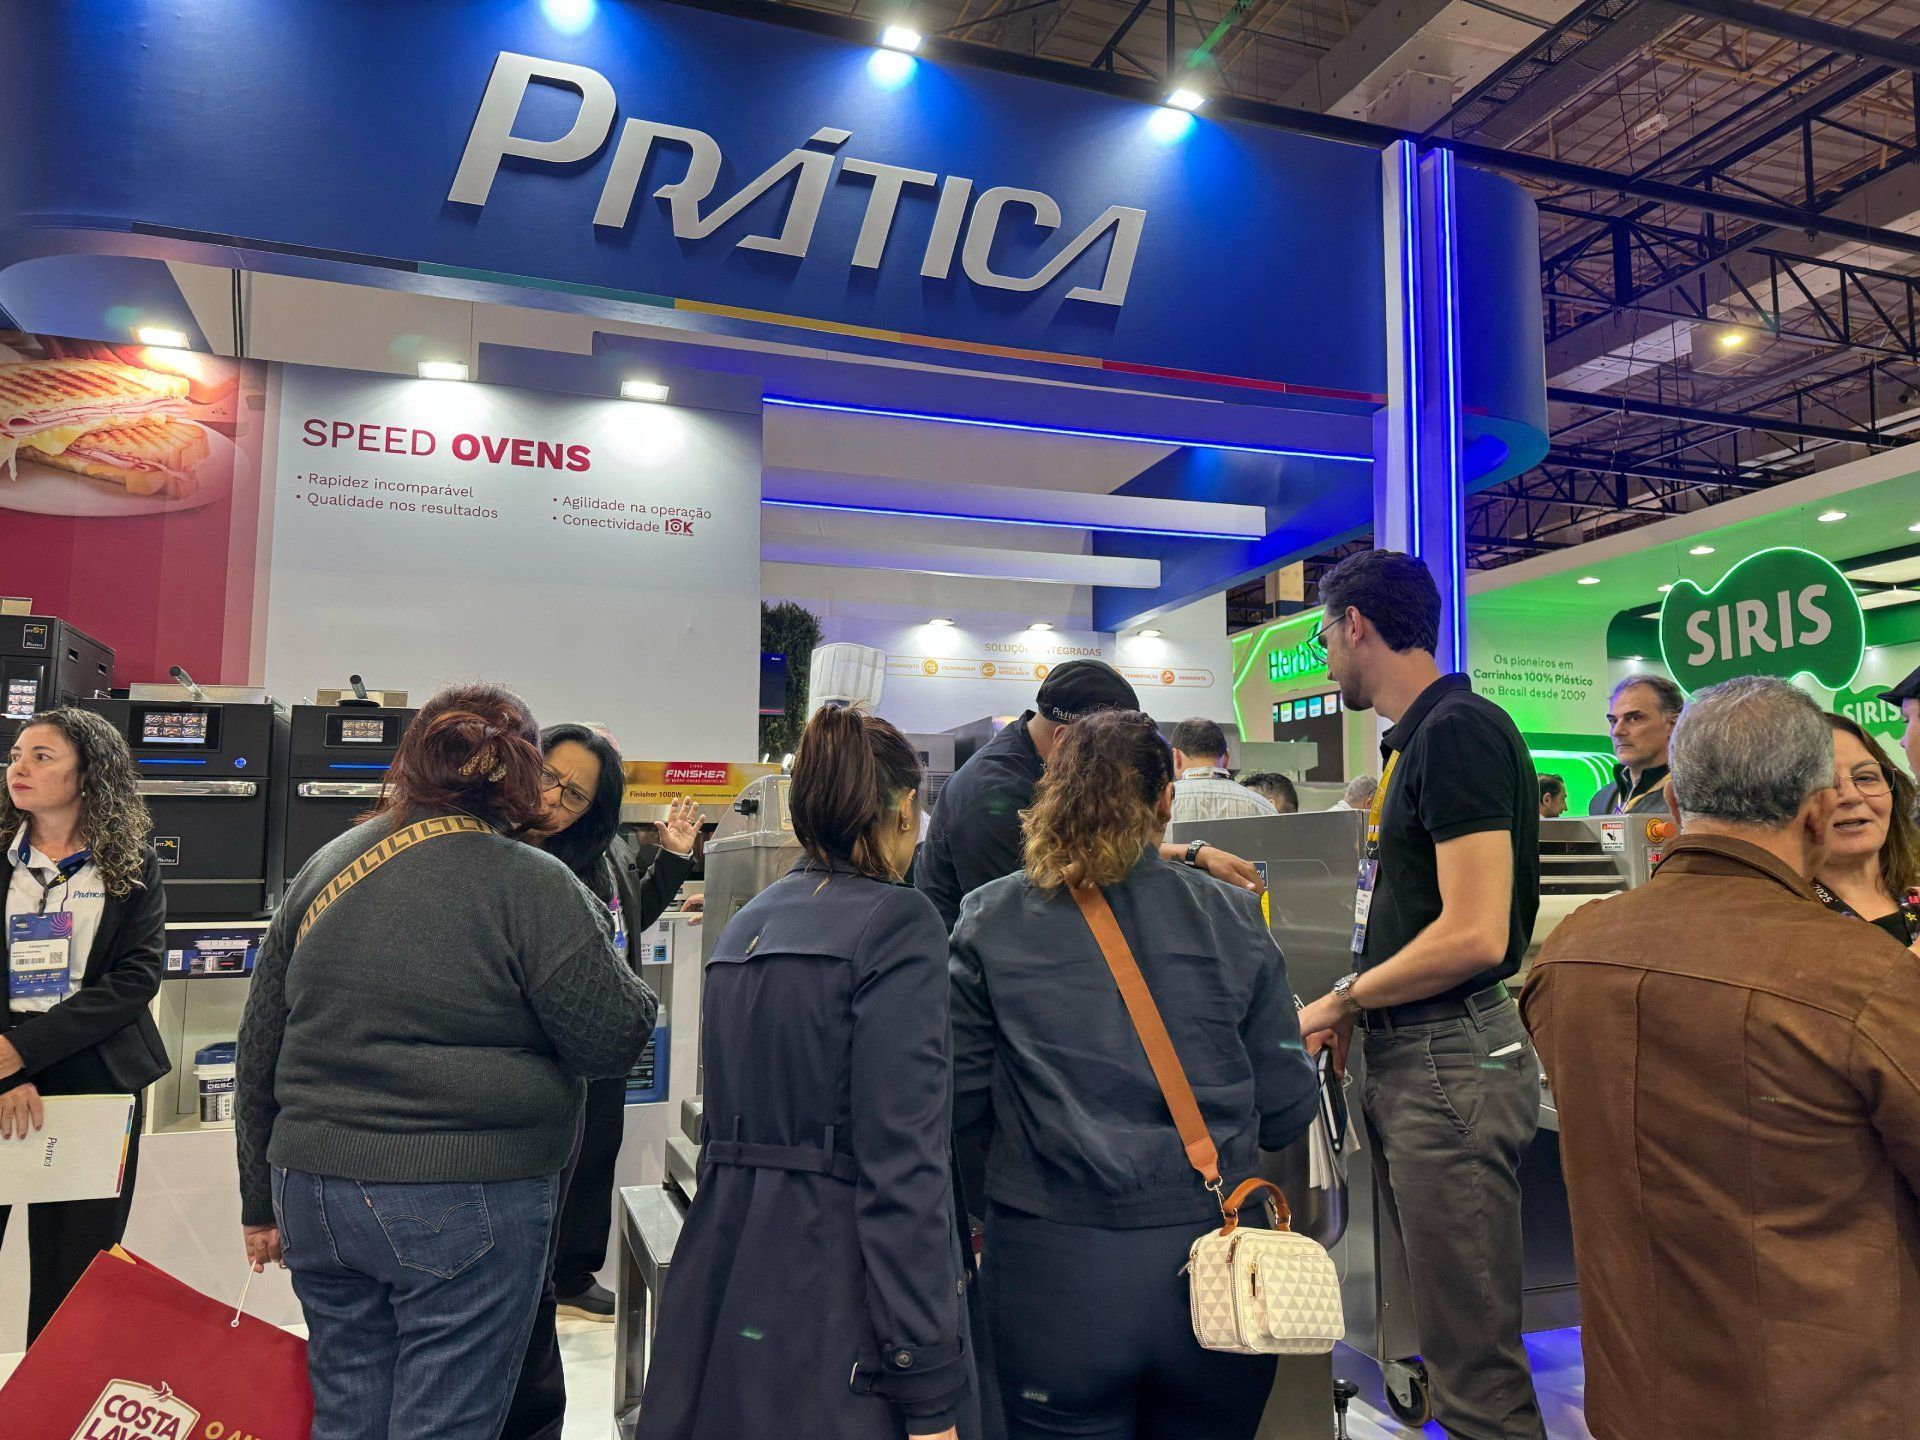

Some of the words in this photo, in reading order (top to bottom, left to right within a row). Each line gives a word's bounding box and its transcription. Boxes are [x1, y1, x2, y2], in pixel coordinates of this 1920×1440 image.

[447, 51, 1147, 306] PRÁTICA
[302, 418, 436, 457] SPEED
[451, 433, 592, 472] OVENS
[308, 472, 369, 491] Rapidez
[374, 478, 474, 498] incomparável
[307, 492, 384, 510] Qualidade
[389, 500, 416, 512] nos
[421, 502, 499, 519] resultados
[562, 496, 625, 511] Agilidade
[630, 504, 646, 513] na
[650, 507, 712, 521] operação
[563, 514, 660, 533] Conectividade
[1686, 584, 1832, 666] SIRIS
[1493, 654, 1508, 665] Os
[1511, 655, 1556, 669] pioneiros
[1558, 661, 1573, 669] em
[1473, 669, 1523, 681] Carrinhos
[1525, 672, 1553, 683] 100%
[1555, 674, 1593, 686] Plástico
[1482, 686, 1495, 695] no
[1498, 686, 1527, 697] Brasil
[1529, 687, 1558, 699] desde
[1561, 690, 1586, 701] 2009
[1842, 701, 1902, 724] SIRIS
[665, 770, 726, 779] FINISHER
[103, 1394, 181, 1439] COSTA
